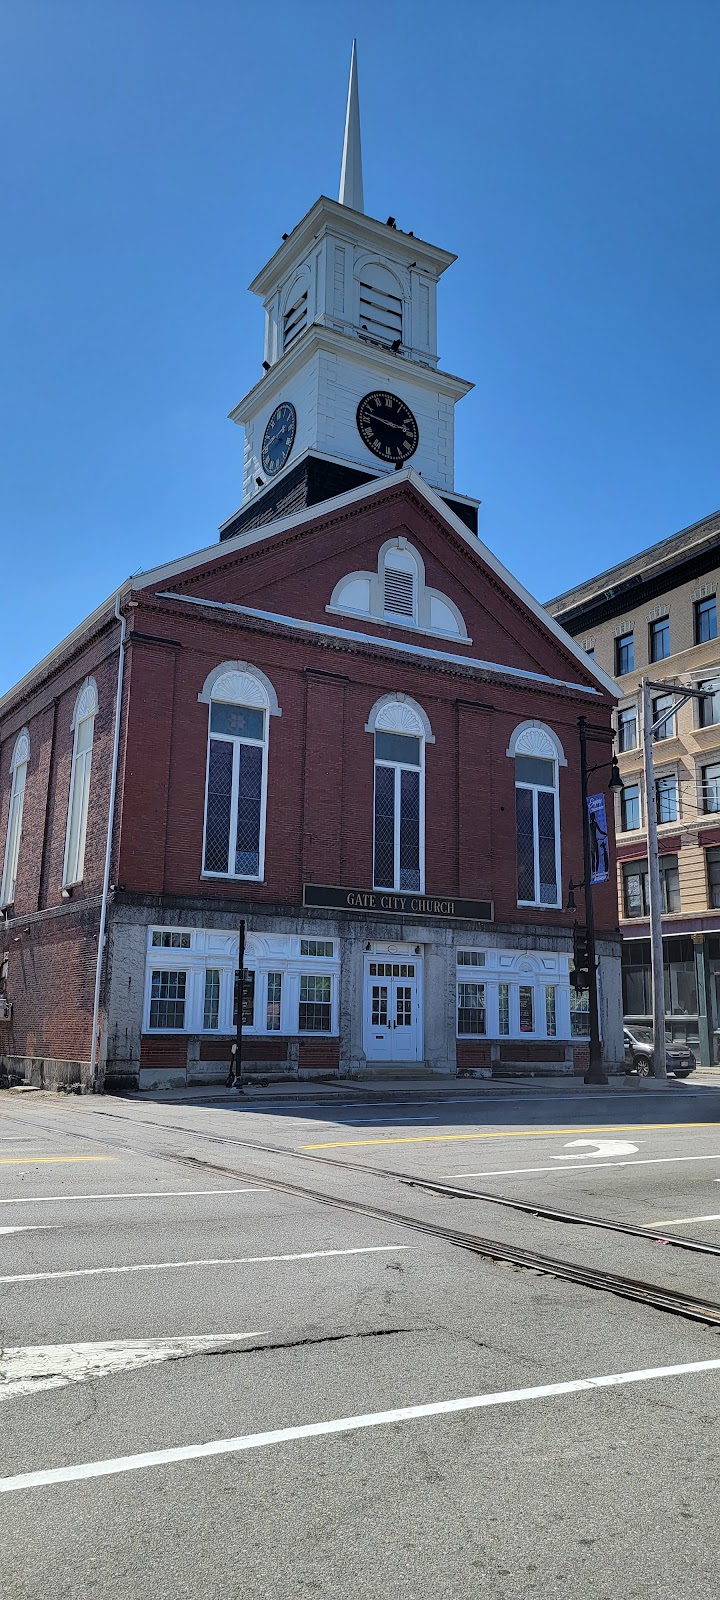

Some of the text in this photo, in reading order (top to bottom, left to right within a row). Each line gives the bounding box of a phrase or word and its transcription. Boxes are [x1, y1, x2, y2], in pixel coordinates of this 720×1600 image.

[346, 892, 455, 914] GATE CITY CHURCH
